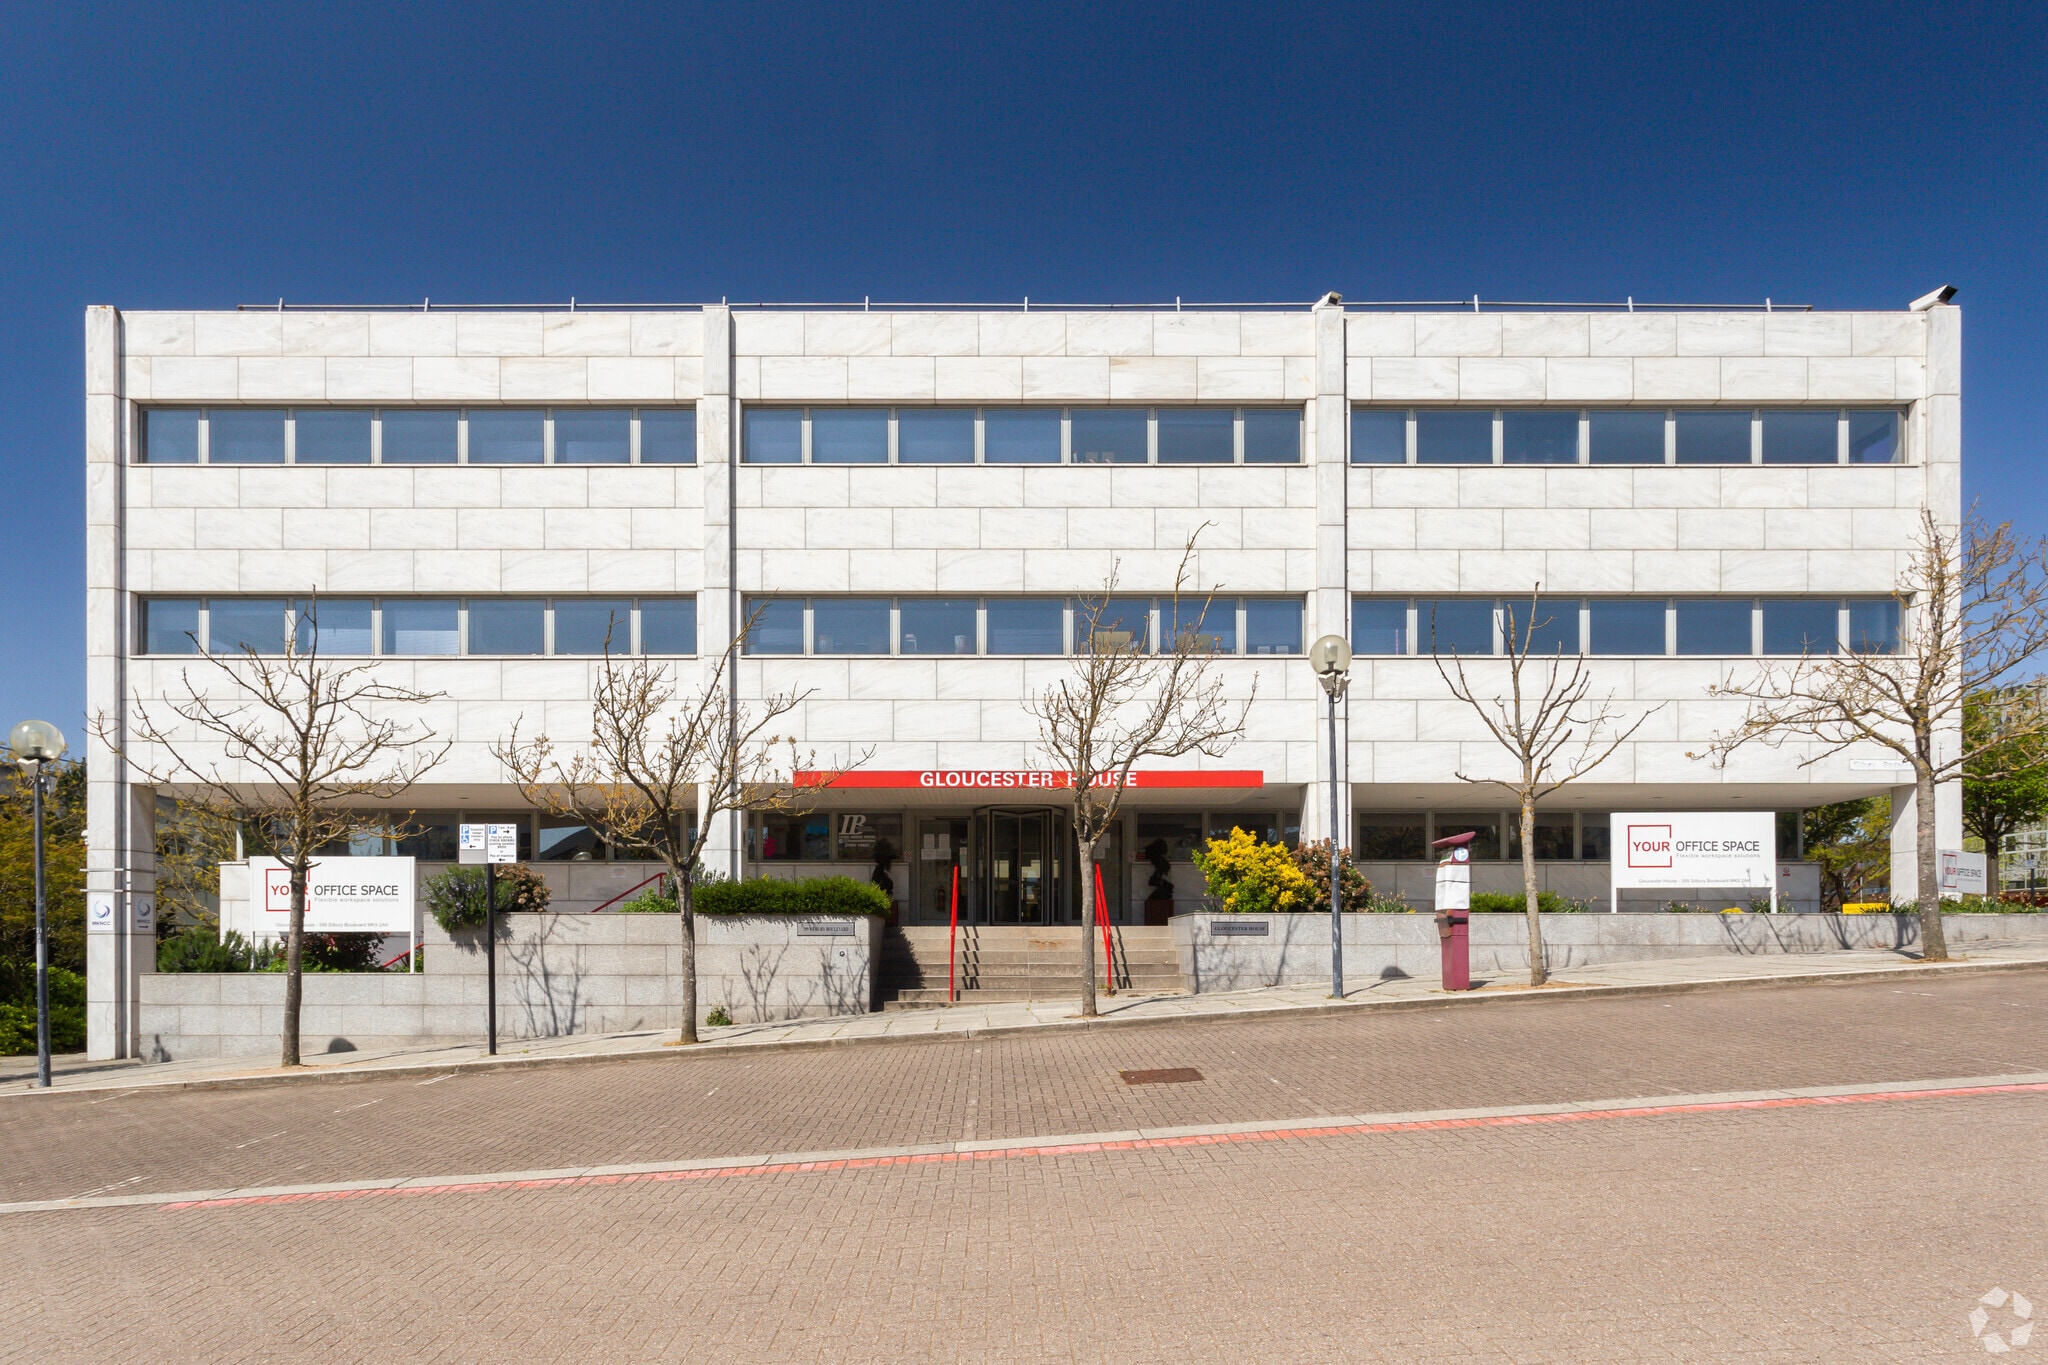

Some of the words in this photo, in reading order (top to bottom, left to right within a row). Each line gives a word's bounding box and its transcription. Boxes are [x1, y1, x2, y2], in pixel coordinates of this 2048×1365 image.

[920, 771, 1053, 787] GLOUCESTER
[1633, 841, 1671, 852] YOUR
[1675, 841, 1718, 852] OFFICE
[1722, 841, 1760, 852] SPACE
[271, 885, 309, 896] YOR
[314, 885, 357, 896] OFFICE
[361, 885, 399, 896] SPACE
